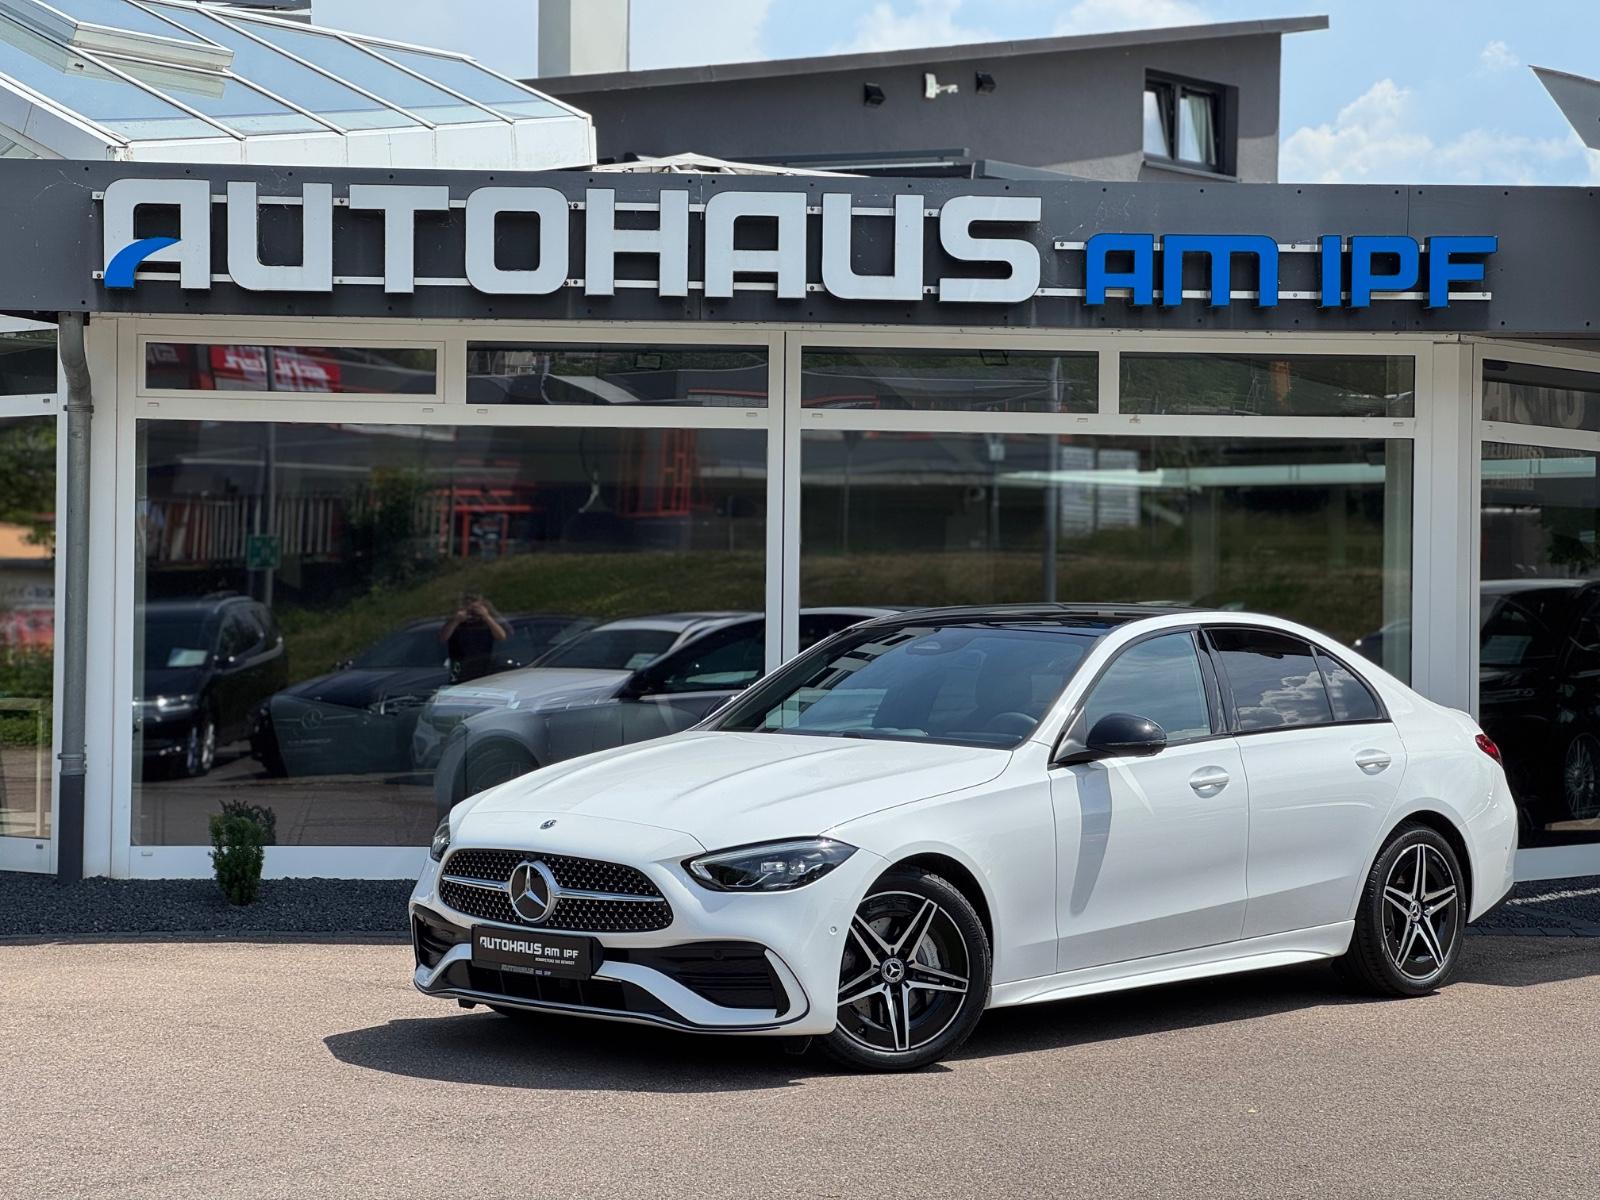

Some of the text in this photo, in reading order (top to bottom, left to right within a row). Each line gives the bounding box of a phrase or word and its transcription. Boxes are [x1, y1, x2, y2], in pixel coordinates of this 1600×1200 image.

[103, 178, 1498, 308] AUTOHAUS AM IPF
[479, 936, 579, 959] AUTOHAUS AM IPF
